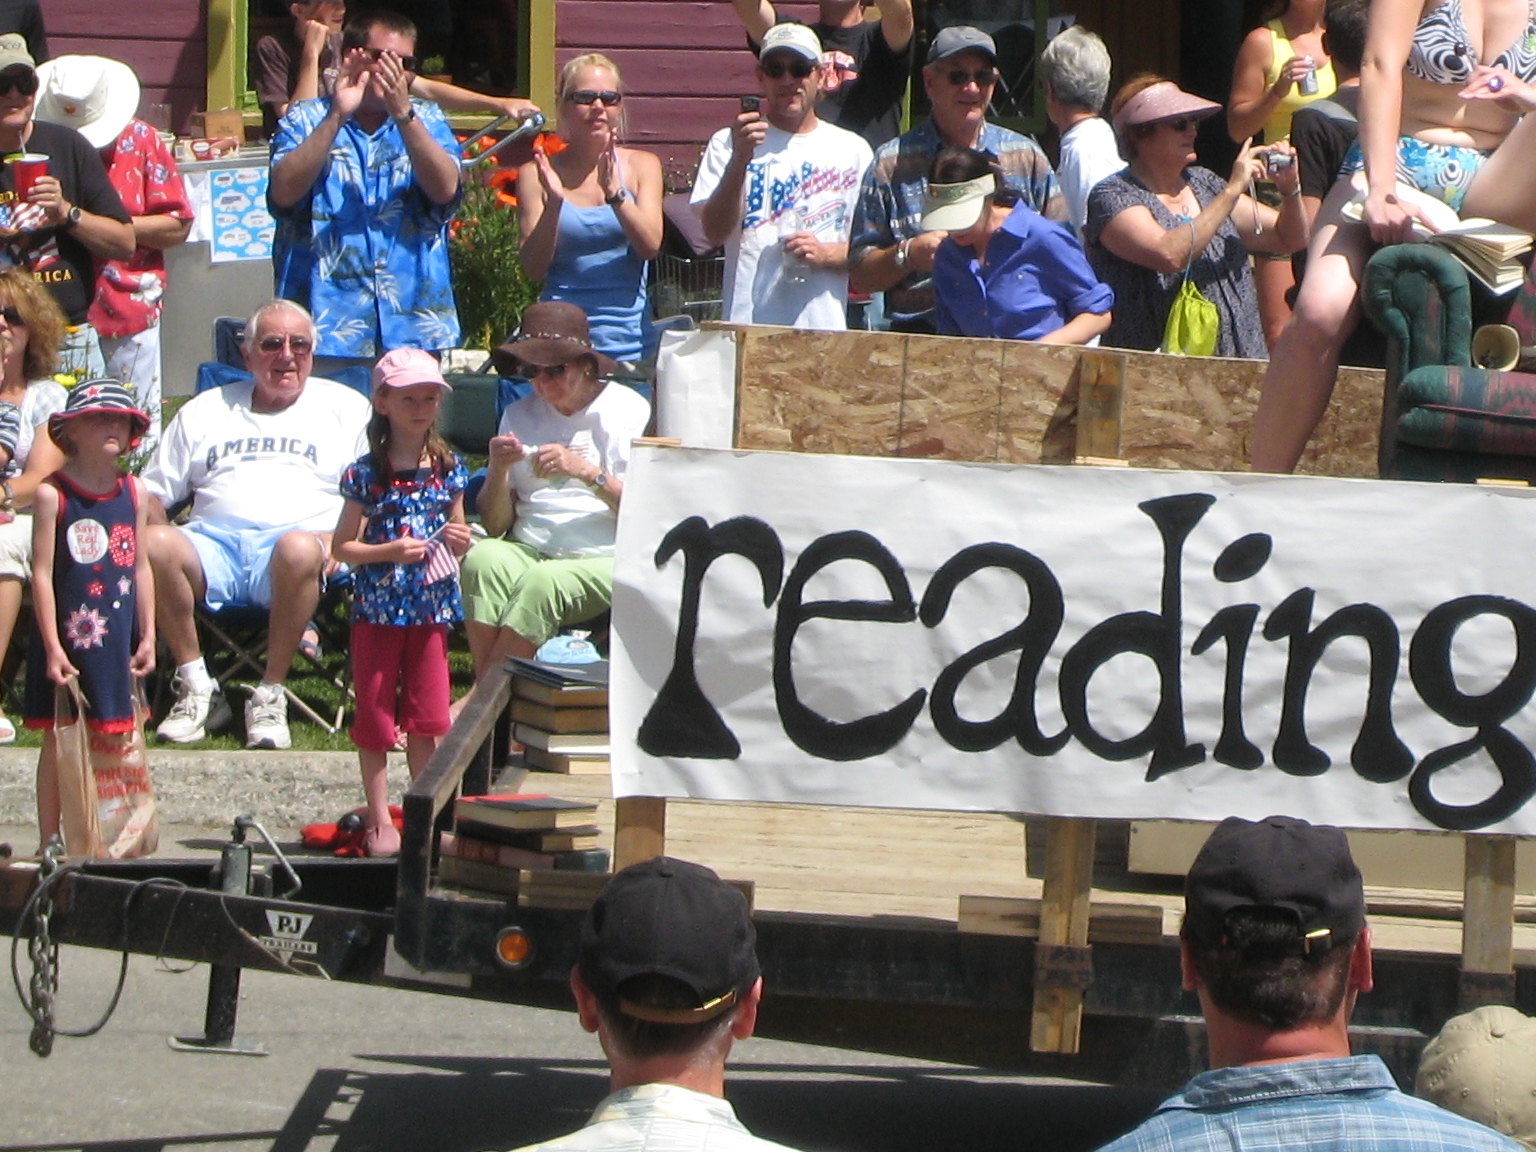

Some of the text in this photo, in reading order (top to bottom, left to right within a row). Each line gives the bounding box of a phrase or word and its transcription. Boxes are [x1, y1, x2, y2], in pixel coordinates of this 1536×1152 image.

[33, 269, 72, 283] RICA
[205, 436, 319, 471] AMERICA
[277, 914, 302, 934] PJ
